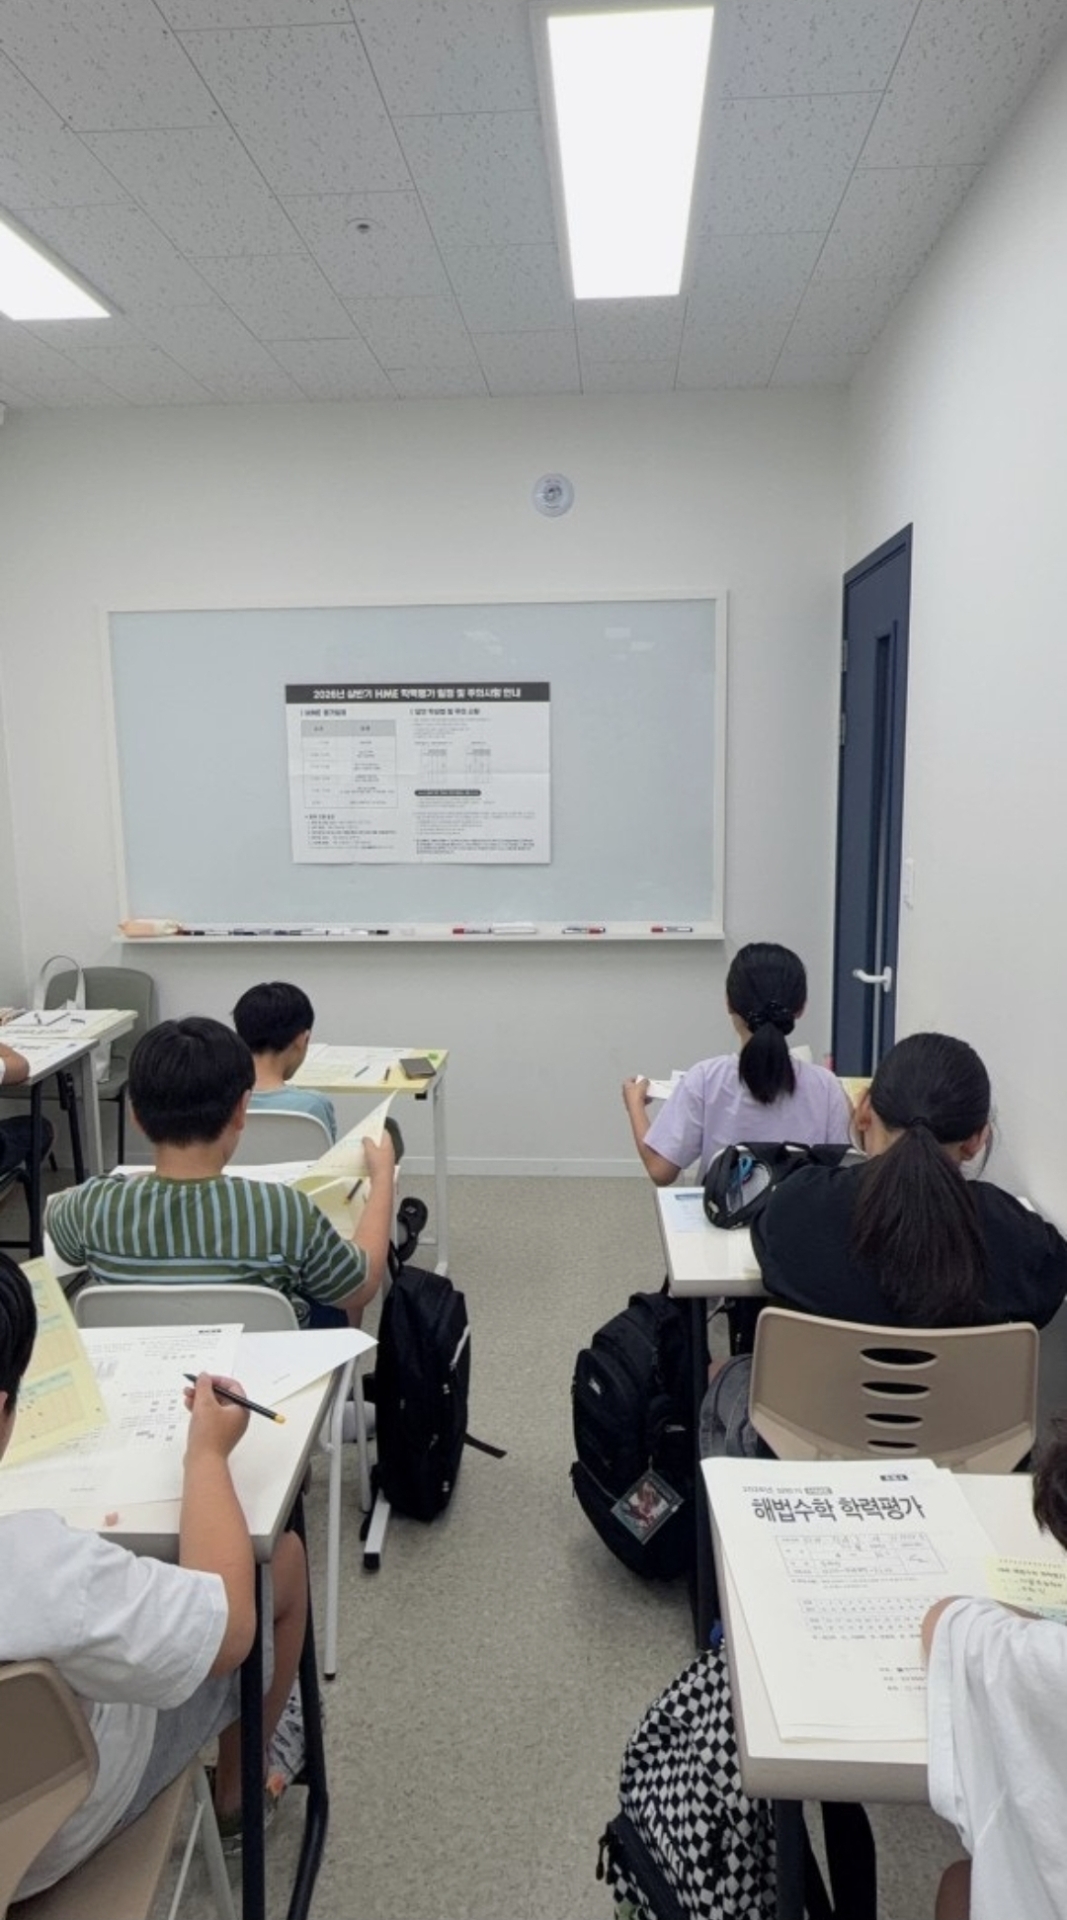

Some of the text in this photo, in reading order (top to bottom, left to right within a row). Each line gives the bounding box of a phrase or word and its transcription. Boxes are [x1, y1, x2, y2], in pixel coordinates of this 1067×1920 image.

[347, 688, 373, 699] 상반기
[374, 688, 399, 699] HME
[401, 687, 435, 699] 학력평가
[467, 687, 502, 698] 주의사항
[503, 687, 521, 698] 안내
[751, 1495, 926, 1524] 해법수학 학력평가
